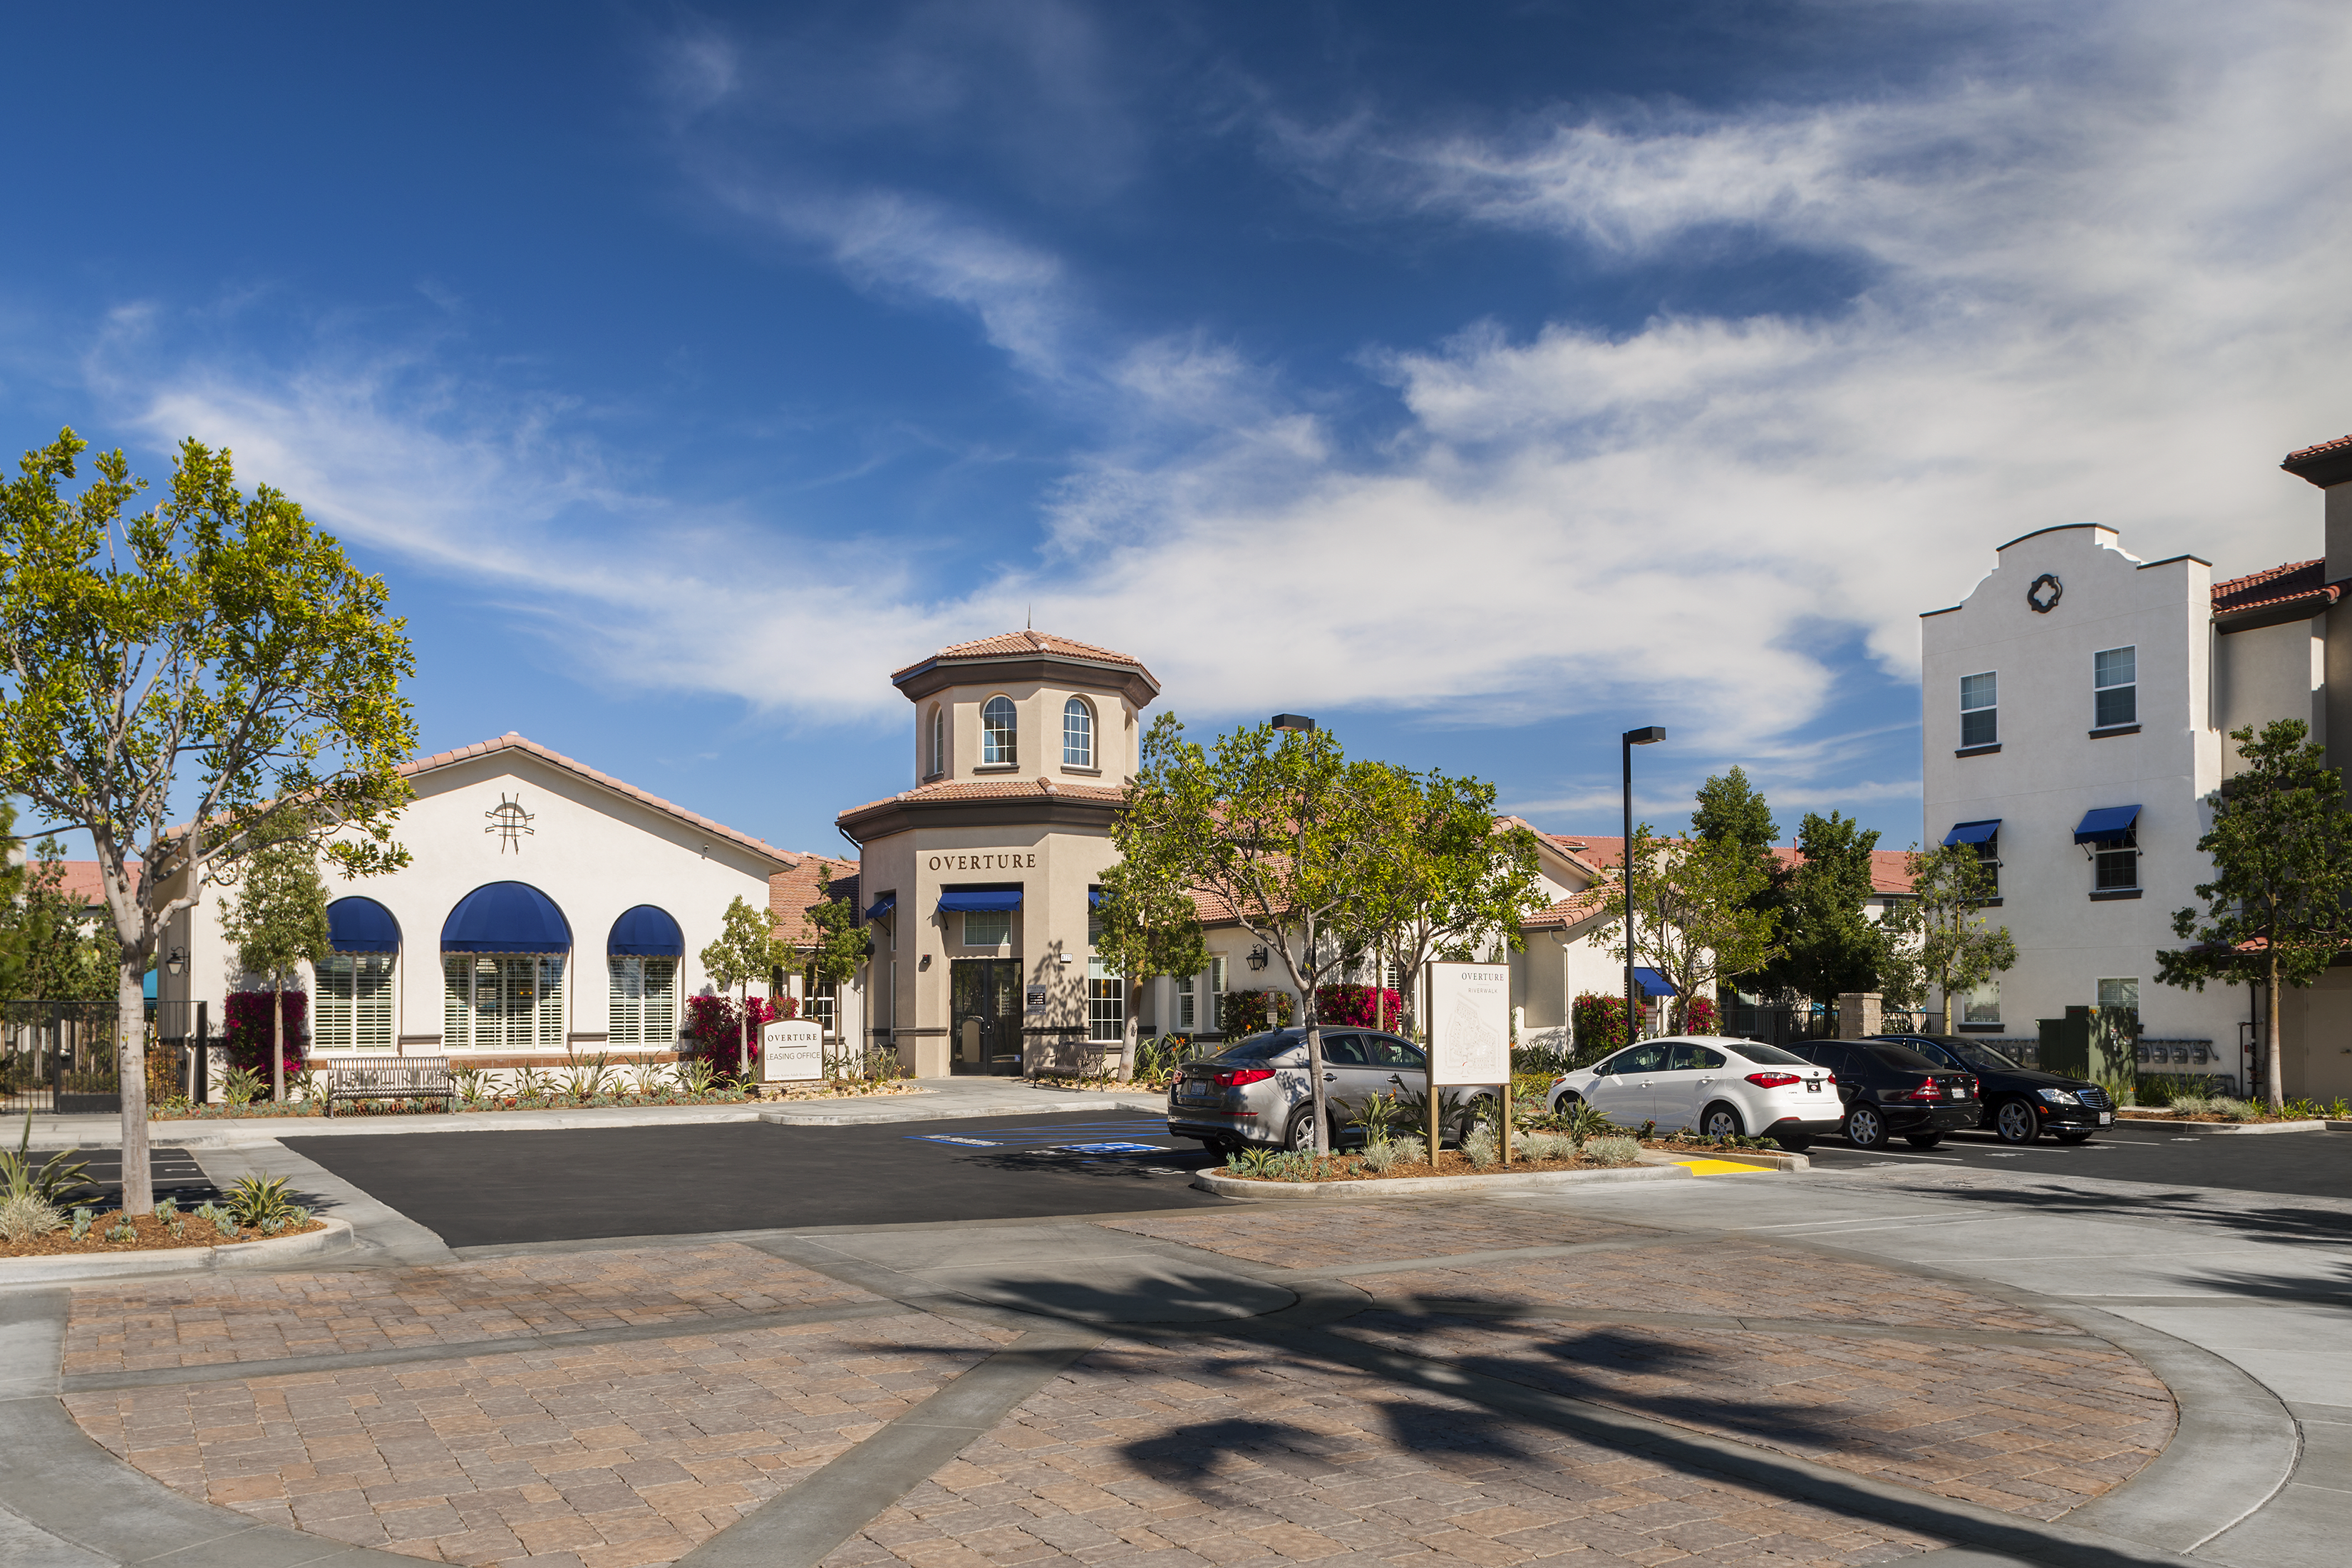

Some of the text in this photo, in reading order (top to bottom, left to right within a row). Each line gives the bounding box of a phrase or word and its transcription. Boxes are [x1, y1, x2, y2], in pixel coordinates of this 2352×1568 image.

[929, 854, 1036, 871] OVERTURE
[1461, 972, 1505, 981] OVERTURE
[768, 1033, 817, 1042] OVERTURE
